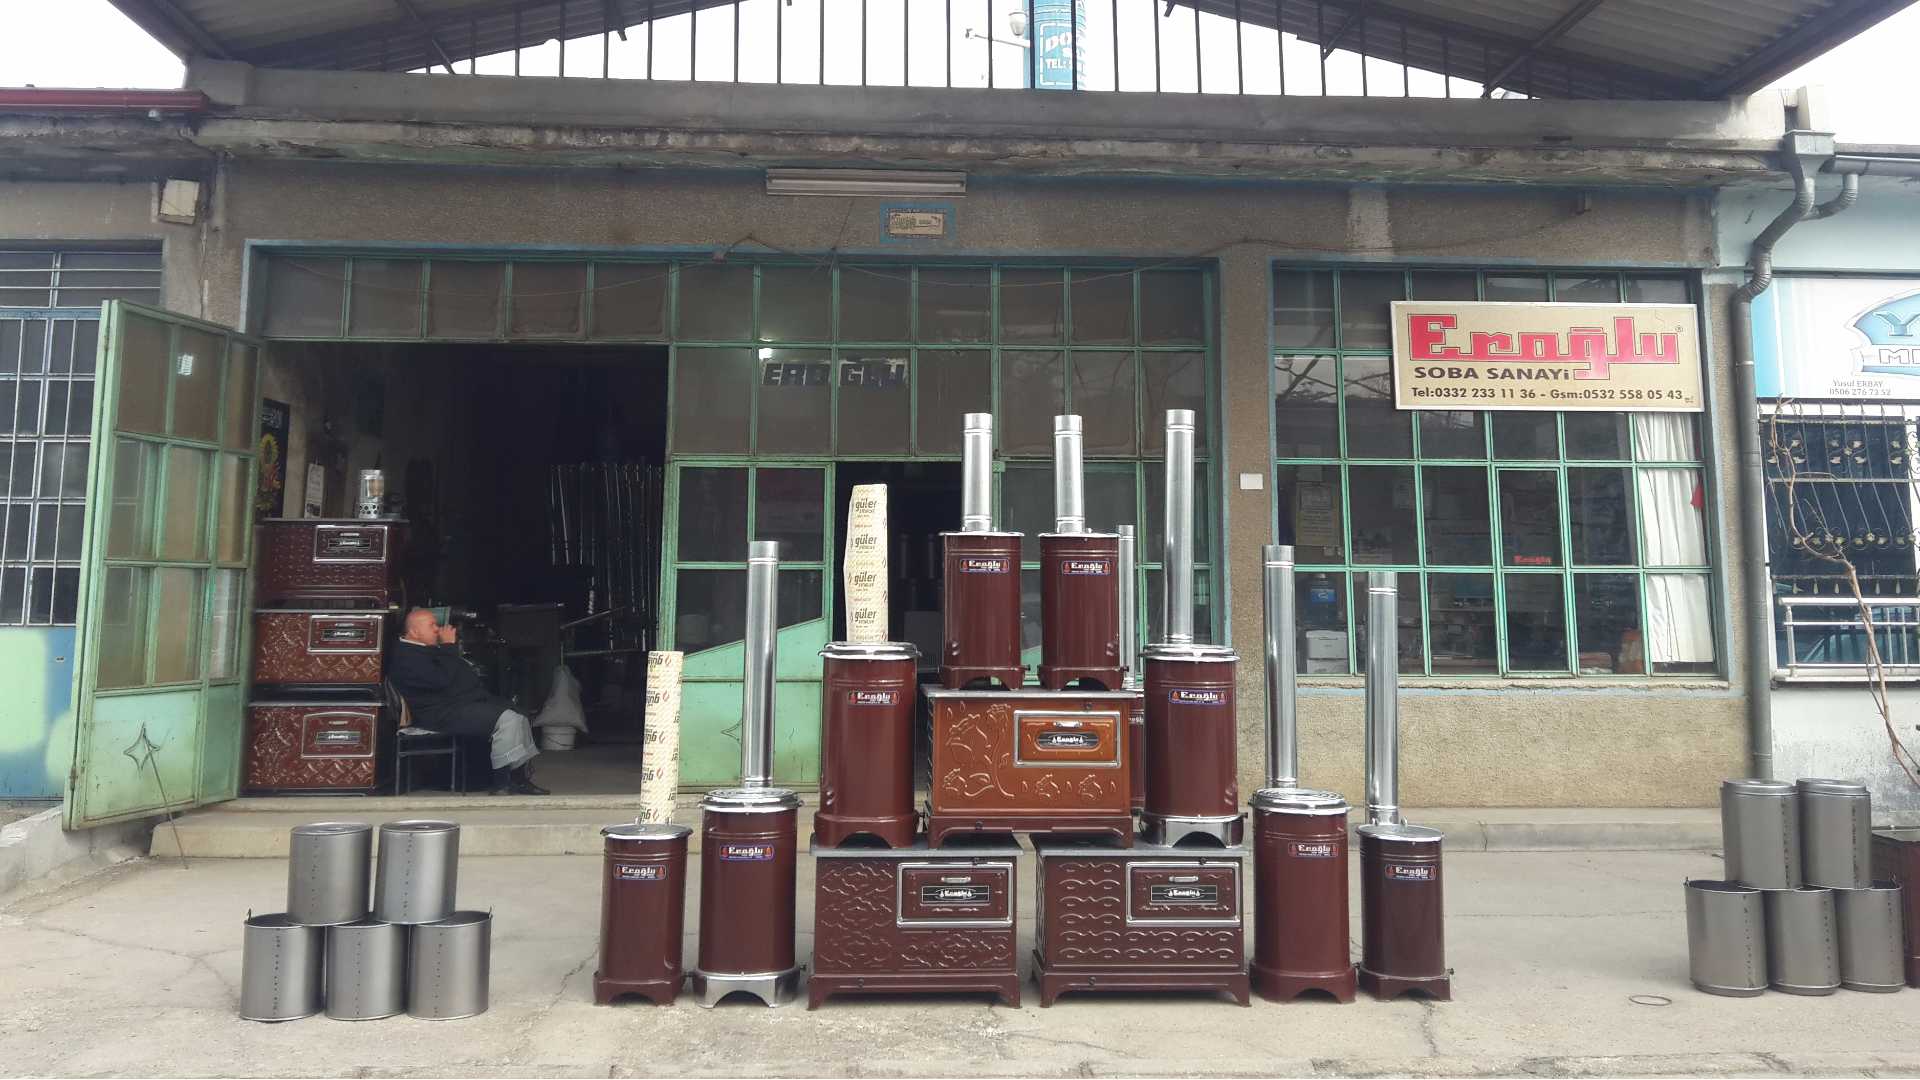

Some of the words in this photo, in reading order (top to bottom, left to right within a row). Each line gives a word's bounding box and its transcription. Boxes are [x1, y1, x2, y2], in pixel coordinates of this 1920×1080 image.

[1414, 366, 1479, 380] SOBA
[1411, 387, 1467, 399] Tel:0332
[1471, 387, 1496, 399] 233
[1501, 388, 1514, 399] 11
[1519, 388, 1536, 399] 36
[1550, 389, 1615, 400] Gsm:0532
[1619, 389, 1643, 400] 558
[1647, 389, 1663, 400] 05
[1667, 390, 1683, 400] 43
[855, 497, 877, 512] güler
[854, 534, 877, 548] güler
[854, 571, 877, 585] güler
[854, 609, 877, 623] güler
